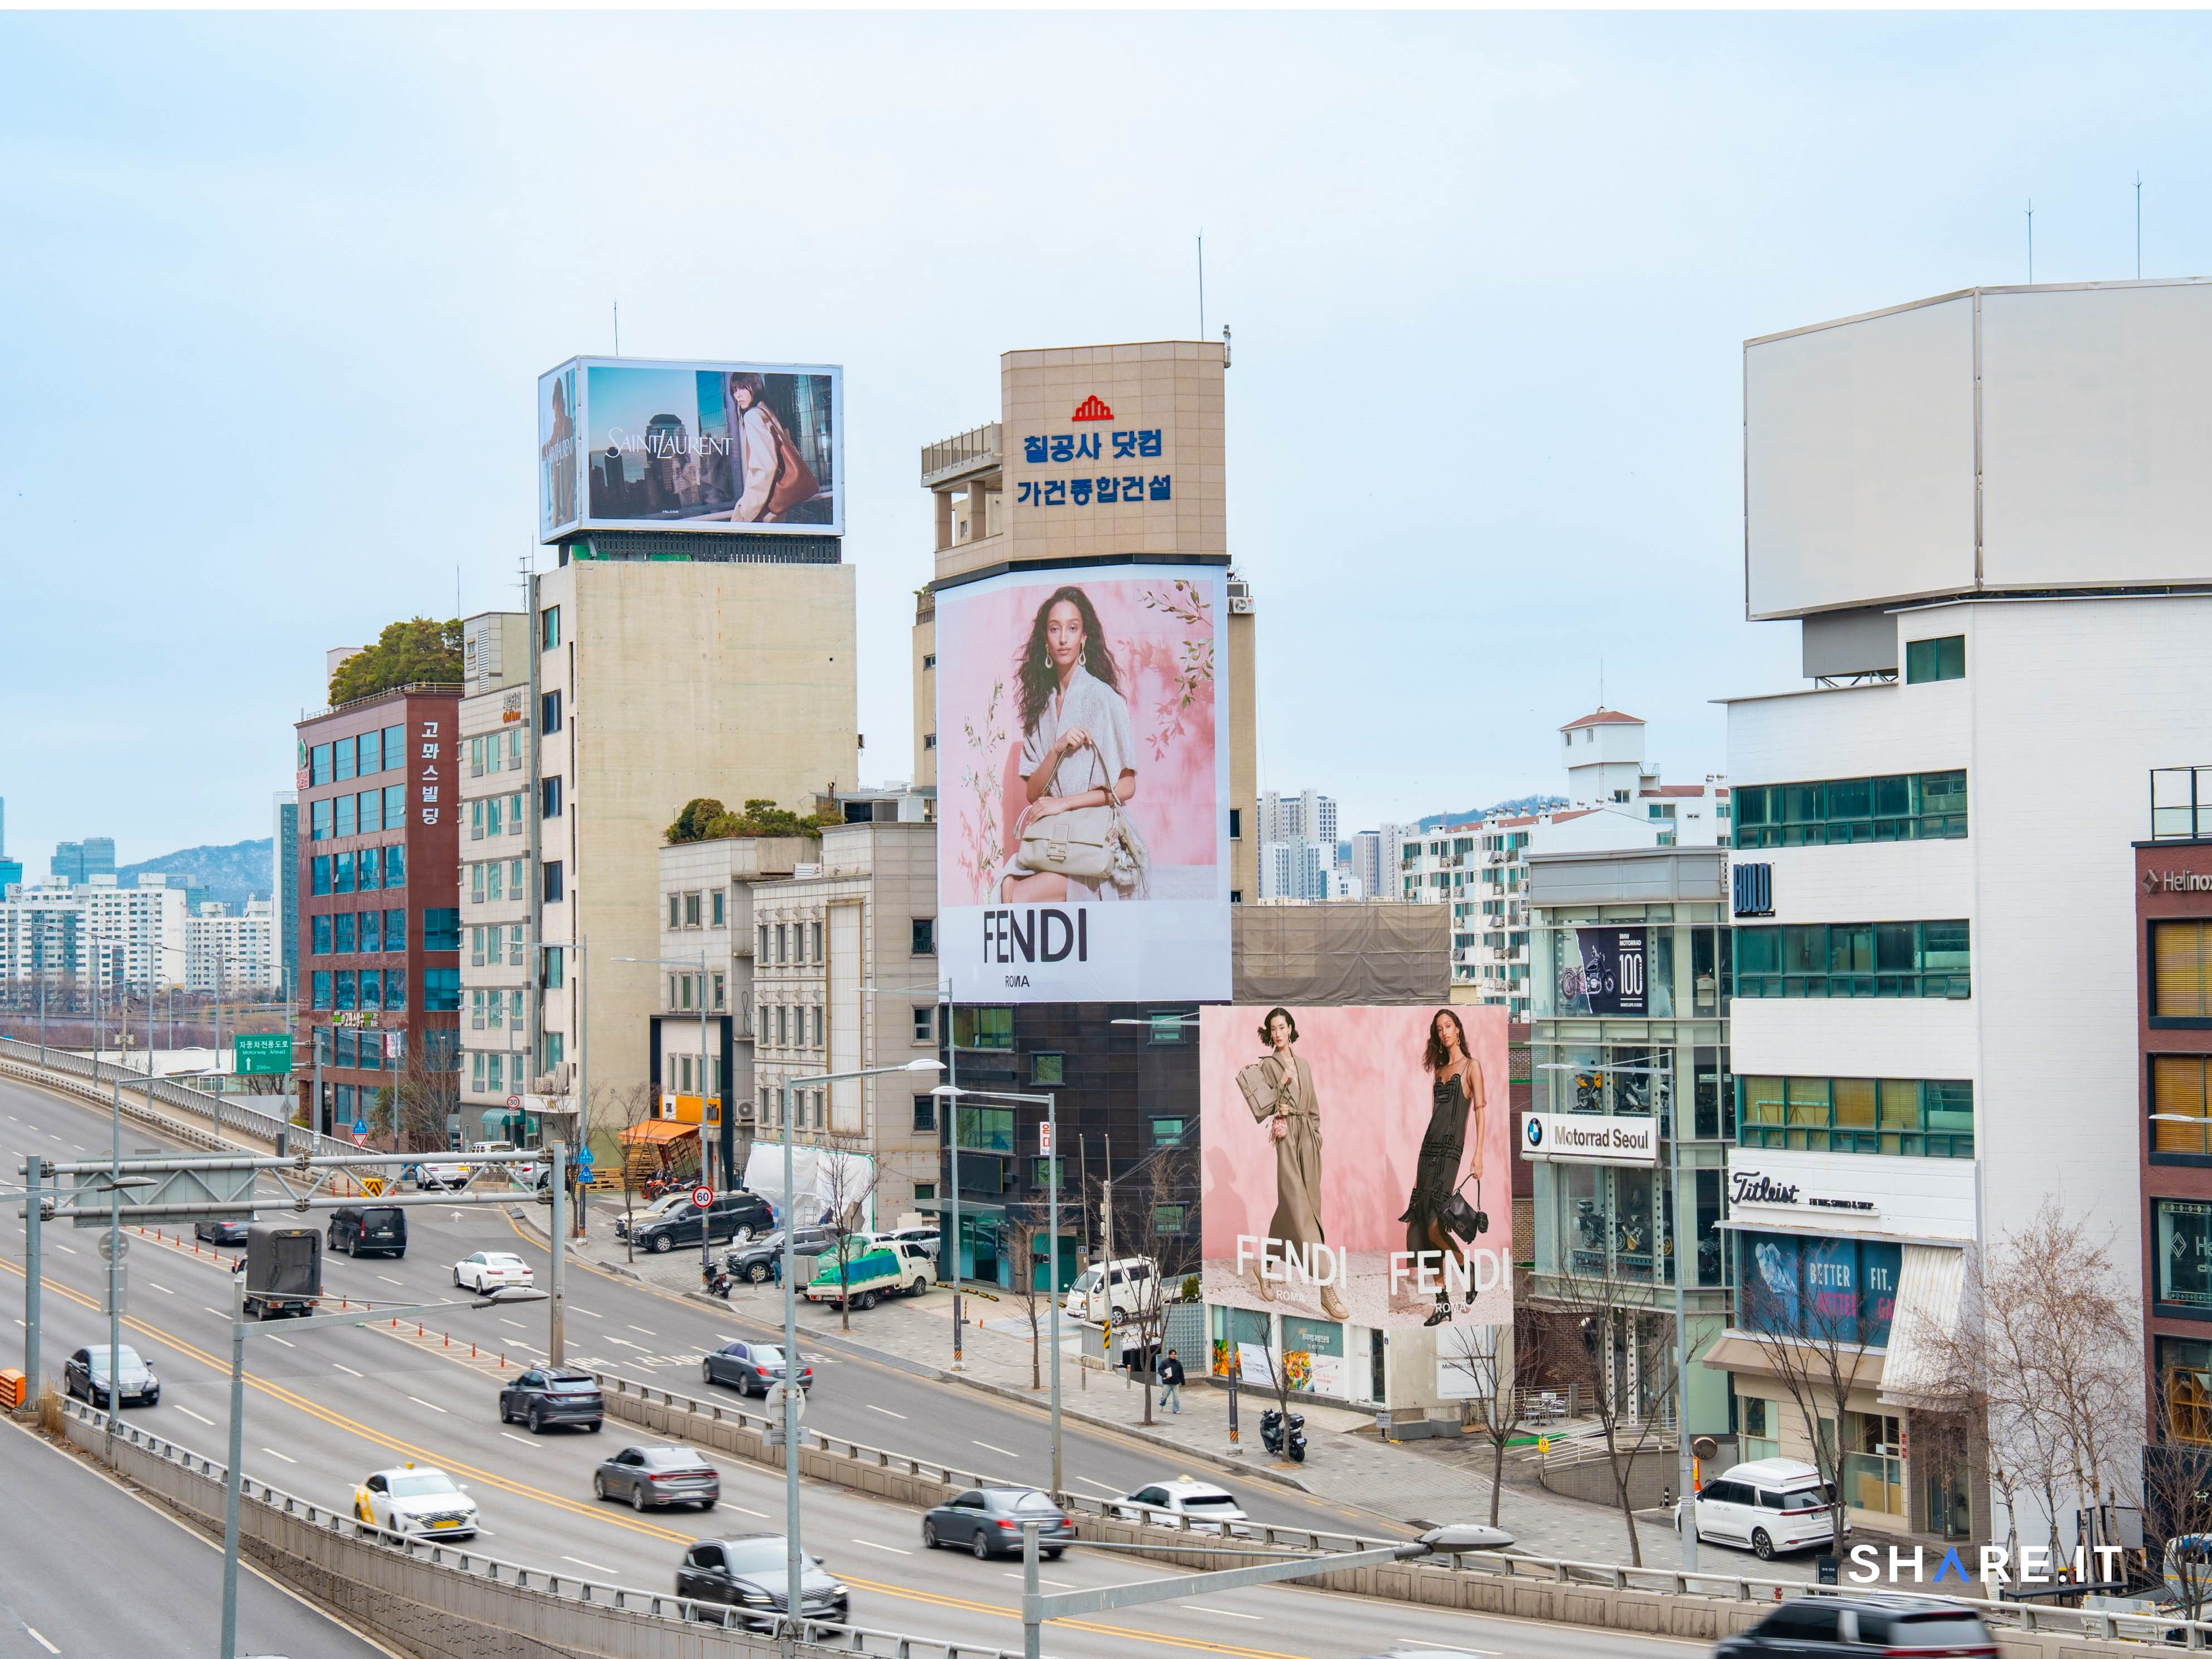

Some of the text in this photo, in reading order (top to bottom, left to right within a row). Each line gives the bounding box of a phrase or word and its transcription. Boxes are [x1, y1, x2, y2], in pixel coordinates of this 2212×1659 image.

[1024, 429, 1162, 463] 칠공사 닷컴
[1017, 474, 1171, 507] 가건종합건설
[1733, 863, 1771, 912] BOLD
[984, 908, 1087, 964] FENDI
[1619, 953, 1643, 995] 100
[239, 1040, 289, 1049] 자동차전용도로
[1554, 1125, 1649, 1150] Motorrad Seoul
[697, 1193, 709, 1202] 60
[1729, 1171, 1800, 1204] Titleist
[1237, 1234, 1346, 1289] FENDI
[1390, 1247, 1509, 1296] FENDI
[1810, 1262, 1892, 1291] BETTER FIT.
[1276, 1290, 1305, 1303] ROMA
[1435, 1302, 1467, 1313] ROMA
